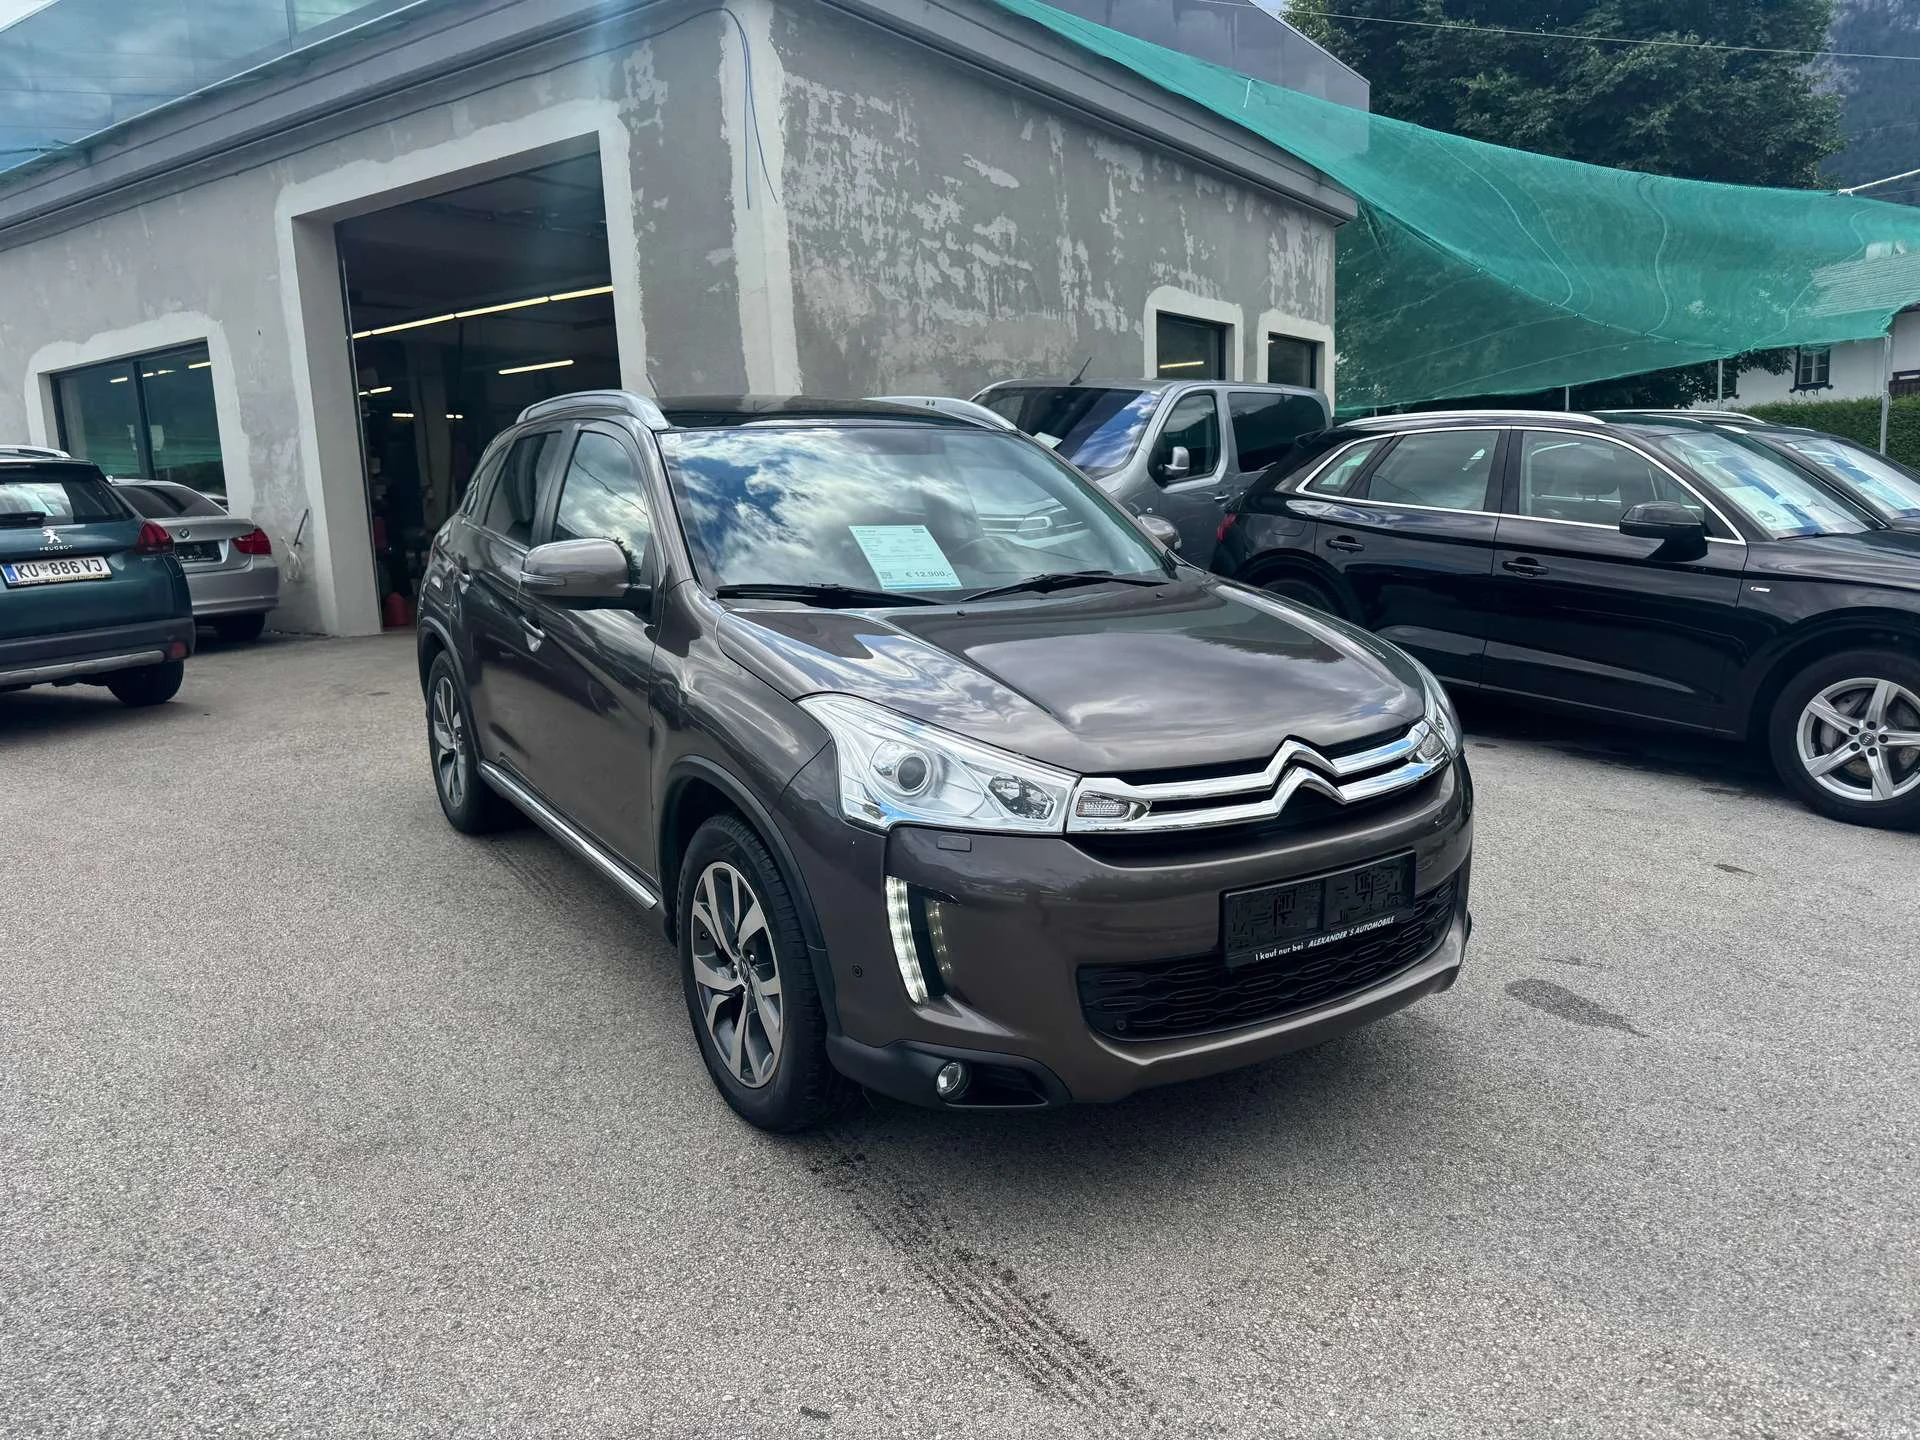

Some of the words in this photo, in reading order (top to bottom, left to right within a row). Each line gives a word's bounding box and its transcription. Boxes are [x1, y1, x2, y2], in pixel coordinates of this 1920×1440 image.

[15, 564, 39, 578] KU
[49, 561, 81, 575] 886
[81, 559, 103, 573] VJ
[1278, 947, 1291, 955] nur
[1292, 942, 1304, 951] bei
[1354, 915, 1395, 935] AUTOMOBILE
